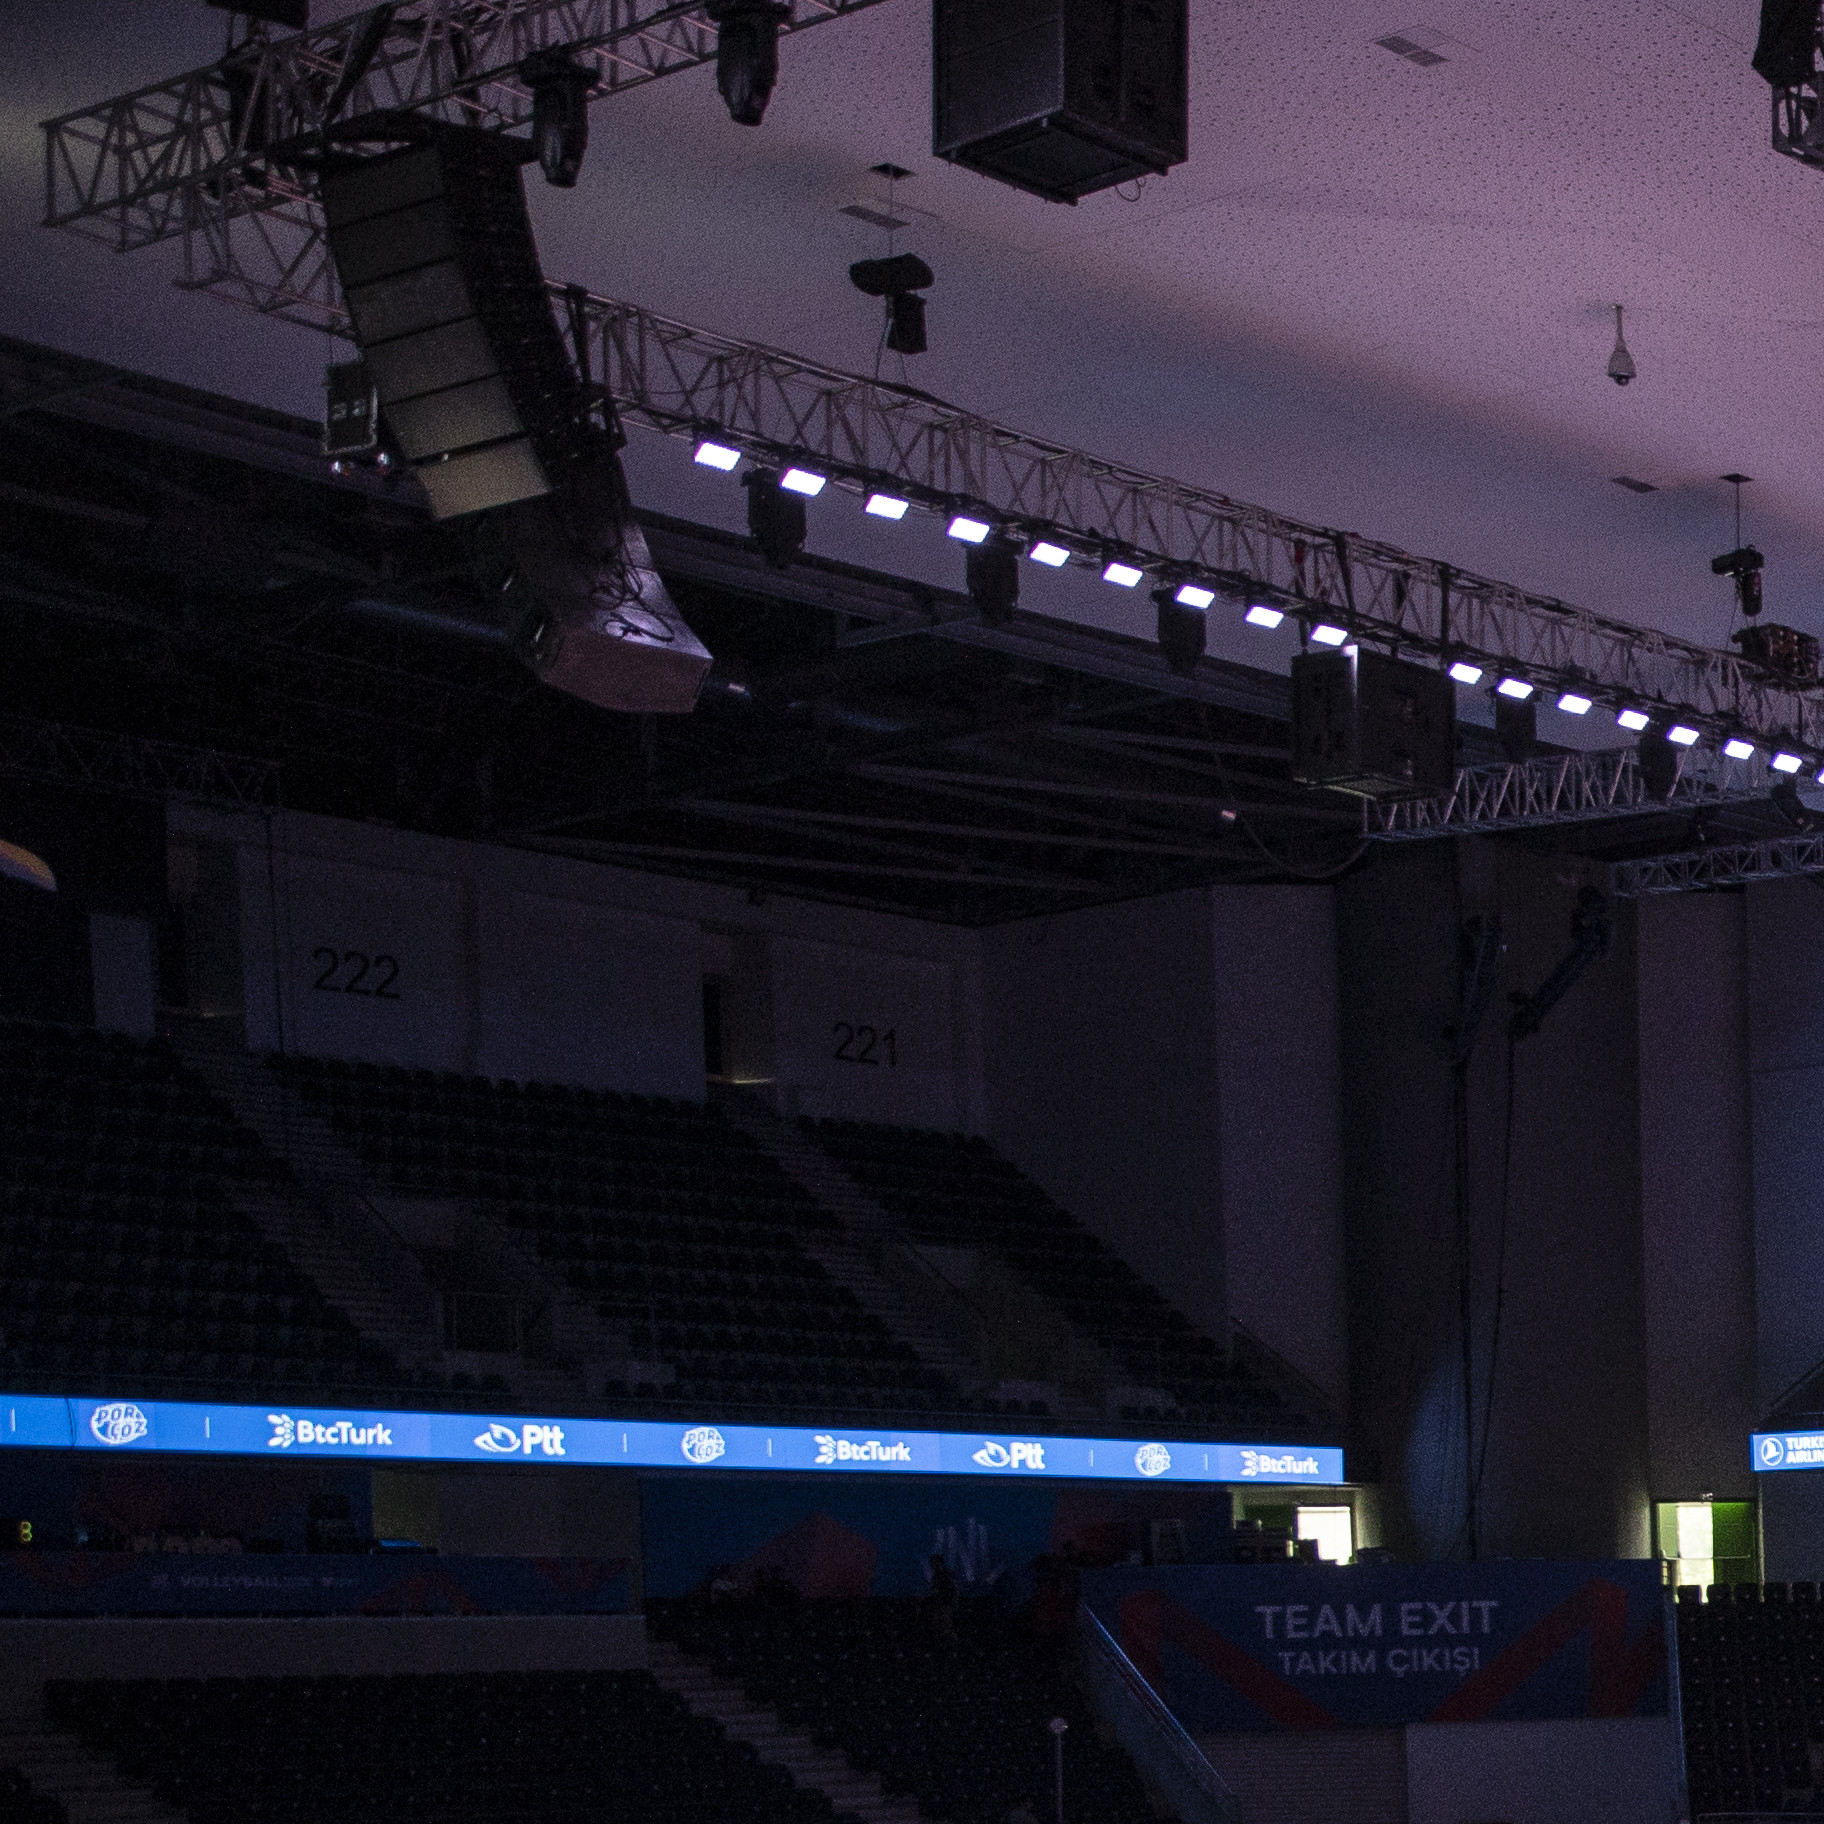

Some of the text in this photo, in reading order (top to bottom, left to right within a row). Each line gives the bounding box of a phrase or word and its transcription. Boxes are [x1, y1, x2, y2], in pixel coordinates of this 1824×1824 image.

[312, 947, 400, 1000] 222
[832, 1021, 898, 1067] 221
[297, 1423, 393, 1446] BtcTurk
[522, 1425, 566, 1456] Ptt
[836, 1441, 911, 1462] BtcTurk
[1010, 1442, 1045, 1470] Ptt
[1259, 1454, 1319, 1475] BtcTurk
[1254, 1600, 1499, 1641] TEAM EXIT
[1278, 1650, 1378, 1676] TAKIM
